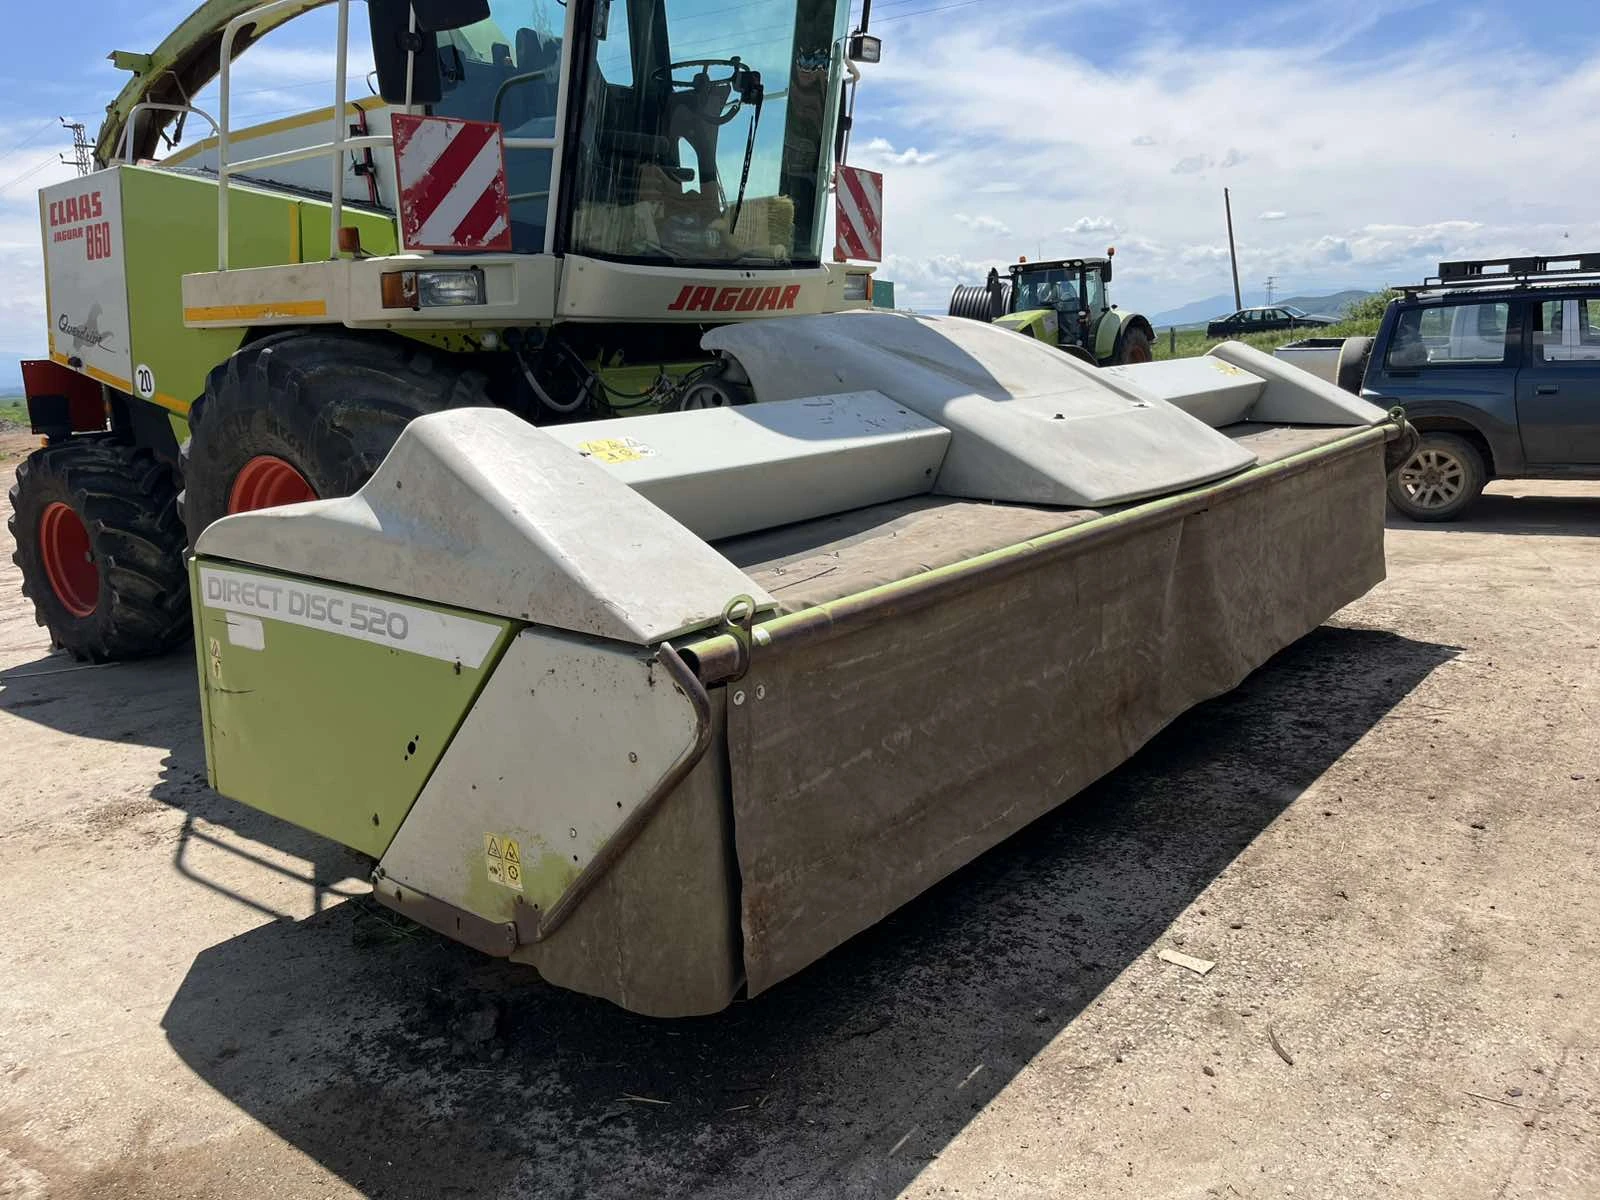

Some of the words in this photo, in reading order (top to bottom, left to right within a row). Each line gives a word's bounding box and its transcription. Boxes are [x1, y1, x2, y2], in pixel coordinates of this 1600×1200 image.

[49, 191, 102, 226] CLAAS
[54, 227, 84, 242] JAGUAR
[86, 221, 112, 260] 860
[667, 284, 801, 312] JAGUAR
[138, 370, 152, 393] 20
[206, 576, 283, 612] DIRECT
[288, 590, 344, 626] DISC
[350, 603, 409, 641] 520
